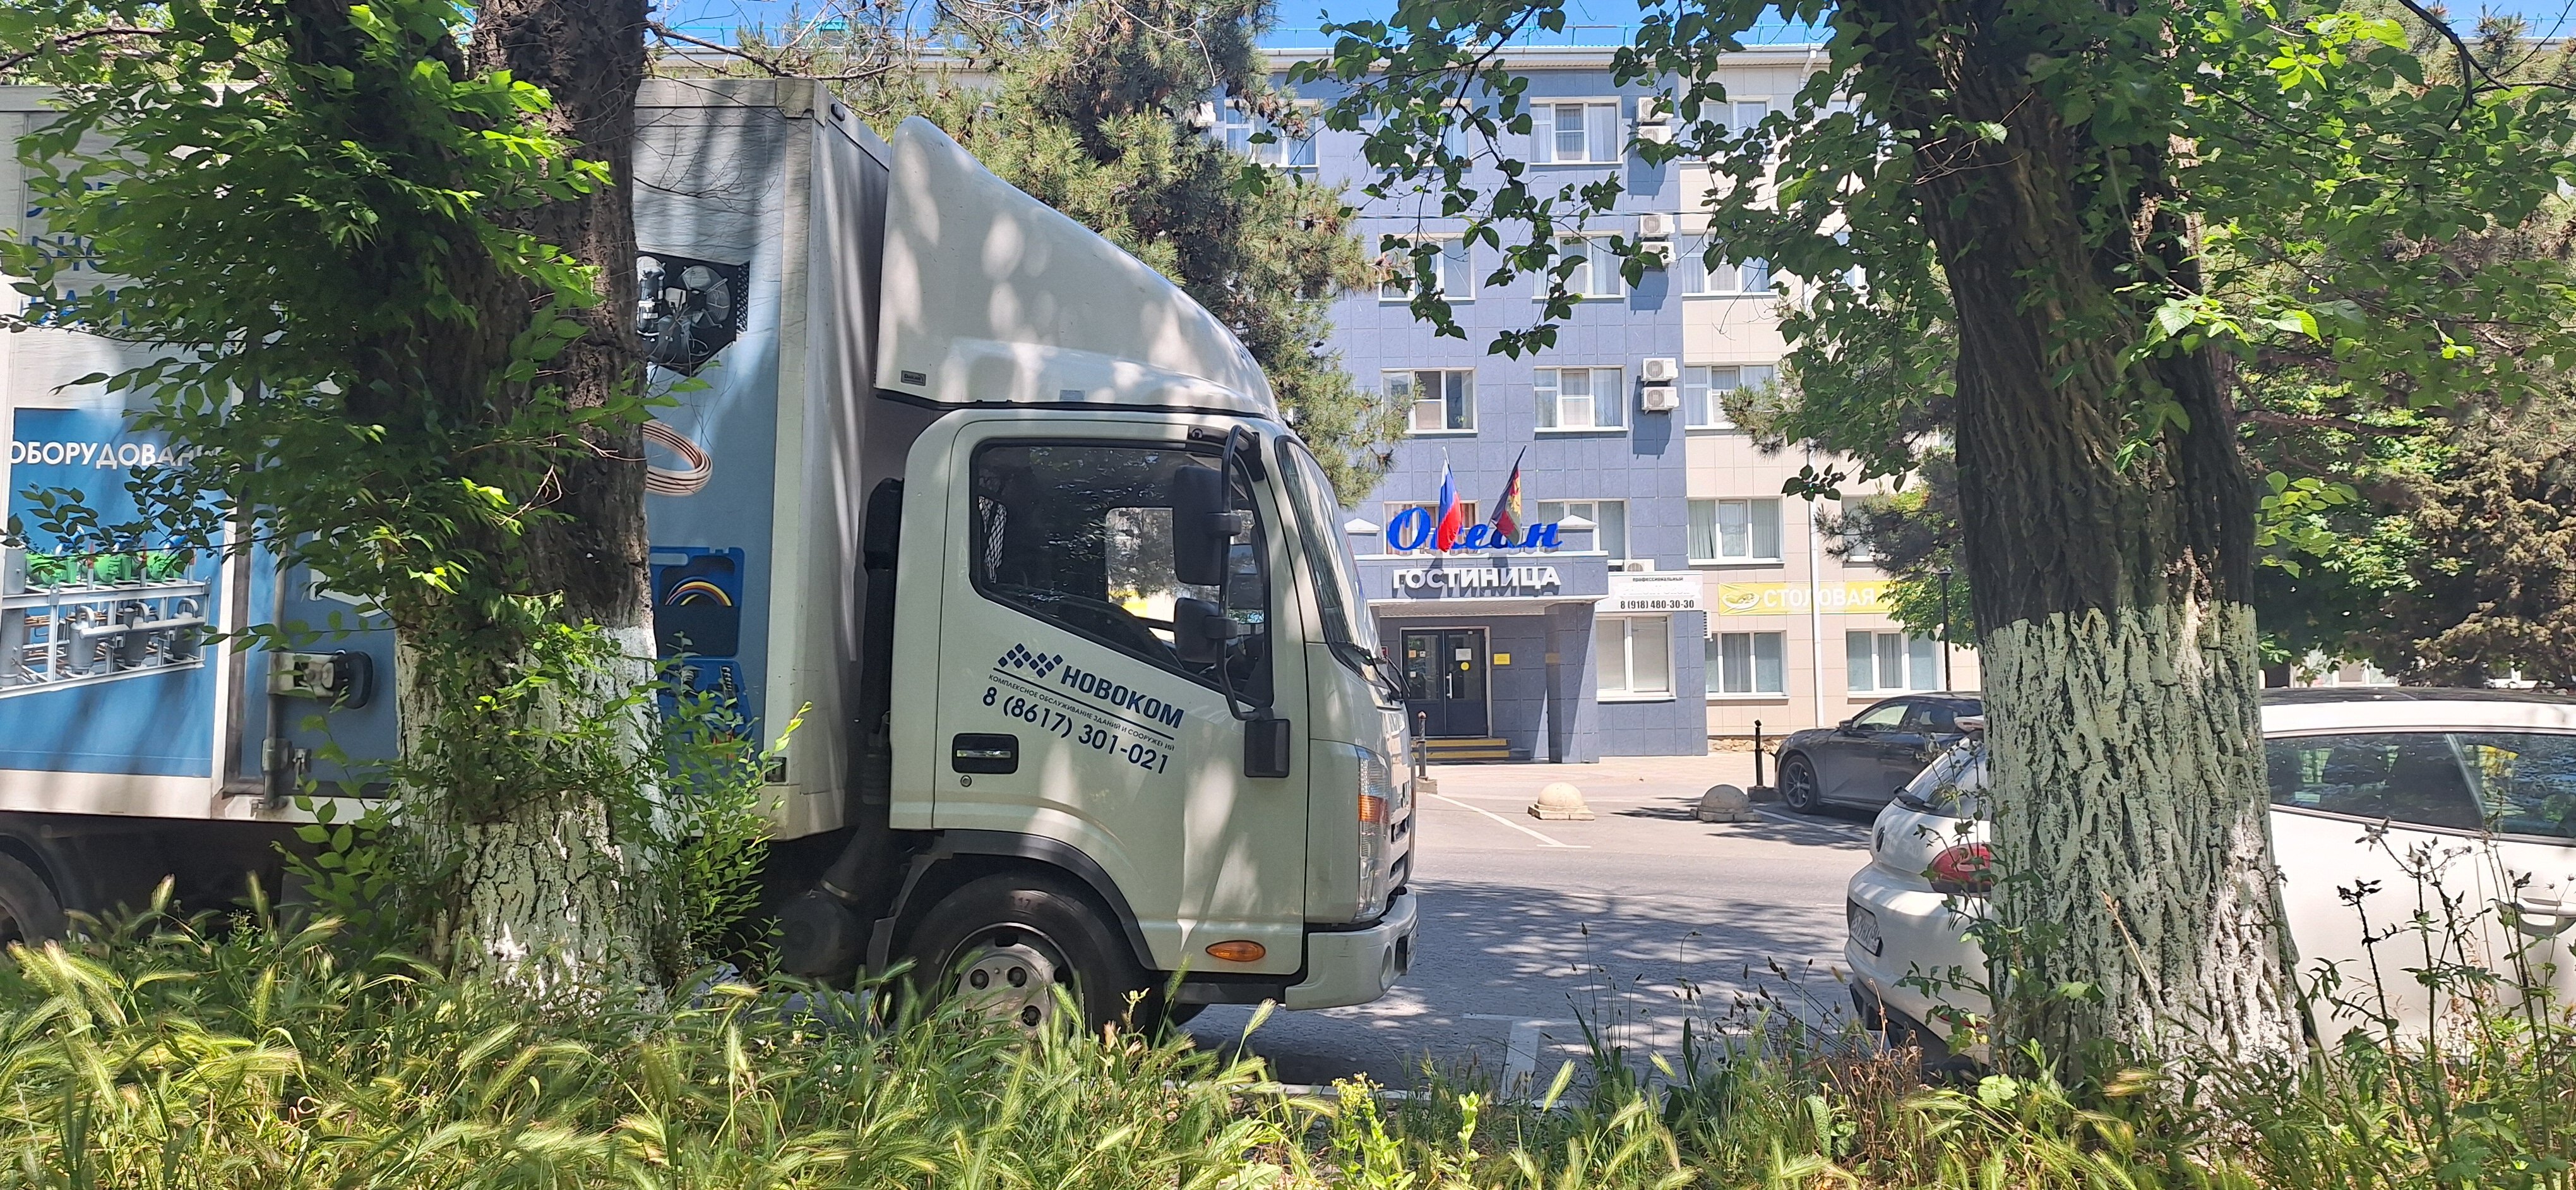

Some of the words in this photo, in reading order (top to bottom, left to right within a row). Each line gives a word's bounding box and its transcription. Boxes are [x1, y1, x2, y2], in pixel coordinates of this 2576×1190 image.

[1393, 567, 1561, 589] ГОСТИНИЦА
[1620, 600, 1626, 609] 8
[1628, 600, 1649, 609] (918)
[1650, 600, 1694, 609] 480-30-30
[988, 674, 1039, 698] КОМПЛЕКСНОЕ
[1039, 694, 1093, 720] ОБСЛУЖИВАНИЕ
[1093, 715, 1121, 730] ЗДАНИЙ
[1060, 665, 1184, 729] НОВОКОМ
[982, 687, 997, 706] 8
[1003, 695, 1072, 738] (8617)
[1078, 724, 1169, 774] 301-021
